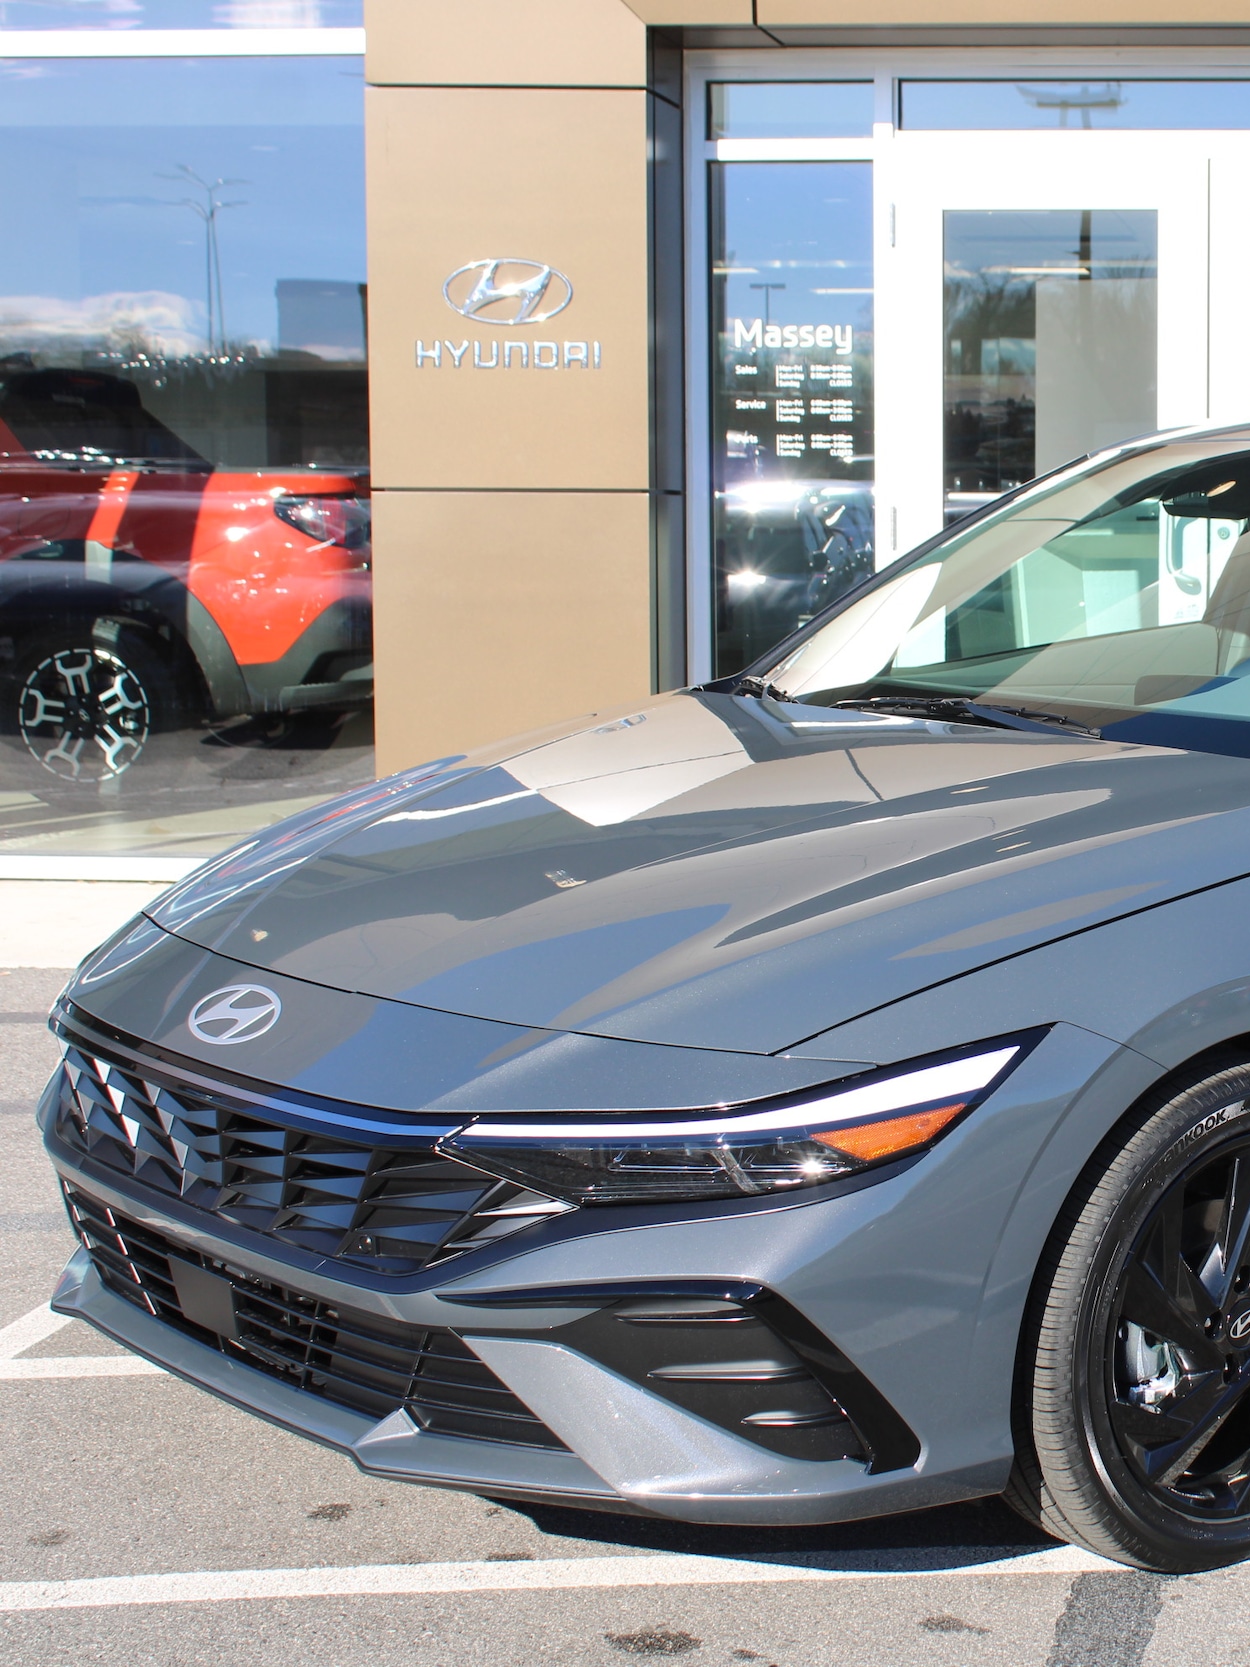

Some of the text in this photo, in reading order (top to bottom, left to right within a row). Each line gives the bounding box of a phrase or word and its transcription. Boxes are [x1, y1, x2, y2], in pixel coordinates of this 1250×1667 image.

[734, 318, 853, 355] Massey
[415, 340, 602, 369] HYUNDAI
[735, 364, 758, 375] Sales
[735, 400, 767, 410] Service
[829, 414, 853, 422] CLOSED
